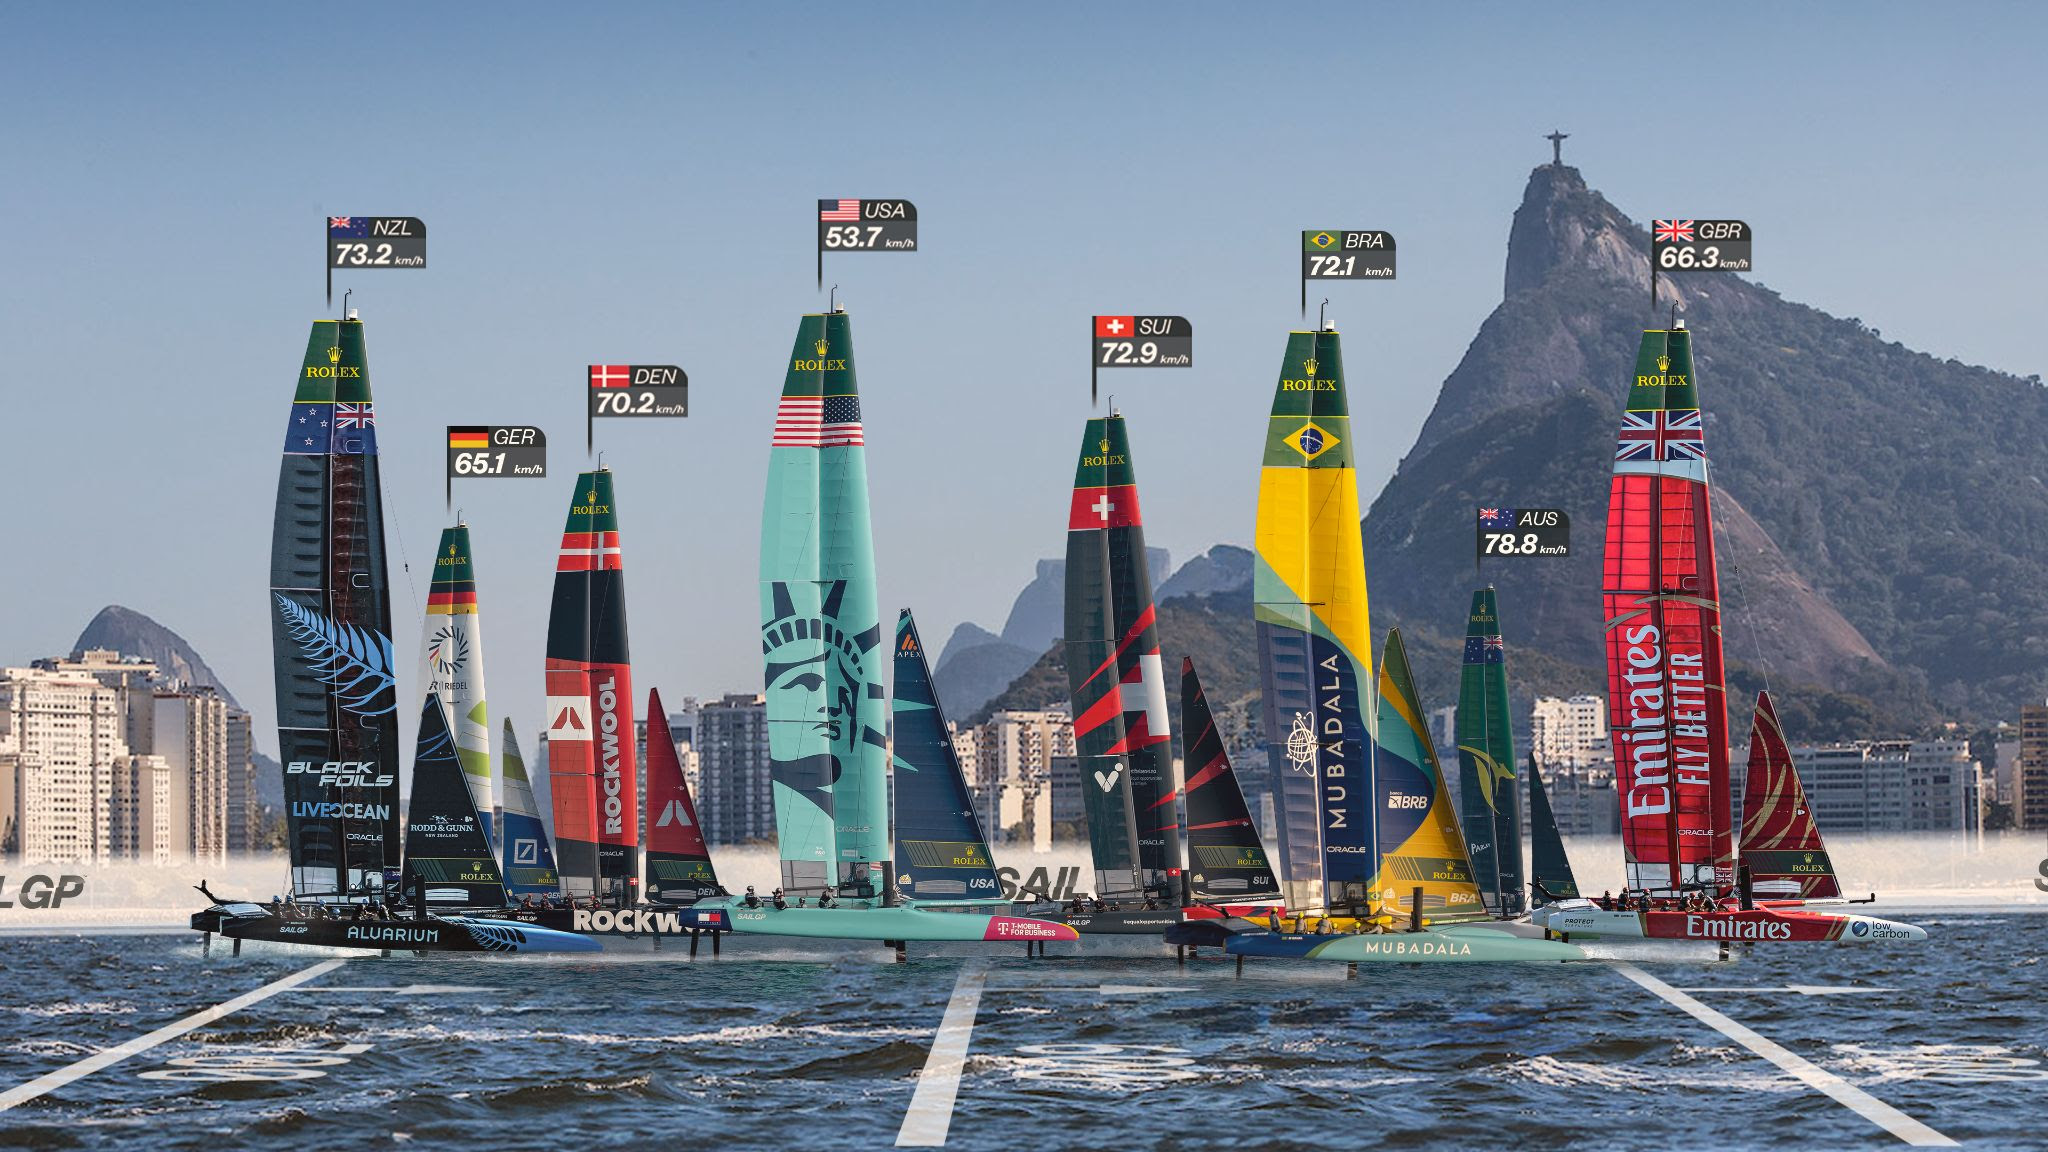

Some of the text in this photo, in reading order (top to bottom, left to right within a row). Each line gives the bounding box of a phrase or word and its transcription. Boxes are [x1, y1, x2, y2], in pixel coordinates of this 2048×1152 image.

[794, 359, 847, 371] ROLEX
[306, 366, 360, 379] ROLEX
[1282, 379, 1337, 391] ROLEX
[1636, 374, 1688, 387] ROLEX
[1083, 454, 1125, 467] ROLEX
[573, 504, 610, 515] ROLEX
[438, 556, 467, 566] ROLEX
[1621, 624, 1671, 819] Emirates
[1670, 653, 1710, 786] FLY BETTER
[1319, 653, 1347, 829] MUBADALA
[599, 675, 622, 835] ROCKWOOL
[286, 761, 375, 774] BLACK
[318, 774, 394, 787] FOILS
[1401, 796, 1428, 809] BRB
[410, 824, 474, 832] RODD & GUNN
[346, 833, 383, 842] ORACLE
[953, 857, 986, 865] ROLEX
[1237, 858, 1262, 866] ROLEX
[1792, 864, 1824, 872] ROLEX
[460, 873, 494, 881] ROLEX
[1252, 876, 1269, 885] SUI
[1433, 871, 1466, 880] ROLEX
[969, 878, 995, 889] USA
[697, 887, 716, 896] DEN
[1450, 892, 1476, 904] BRA
[573, 909, 729, 933] ROCKW
[1872, 920, 1891, 929] low
[1025, 929, 1056, 937] BUSINESS
[1686, 915, 1792, 940] Emirates
[1872, 929, 1910, 938] carbon
[347, 925, 439, 943] ALVARIUM
[1366, 942, 1471, 955] MUBADALA
